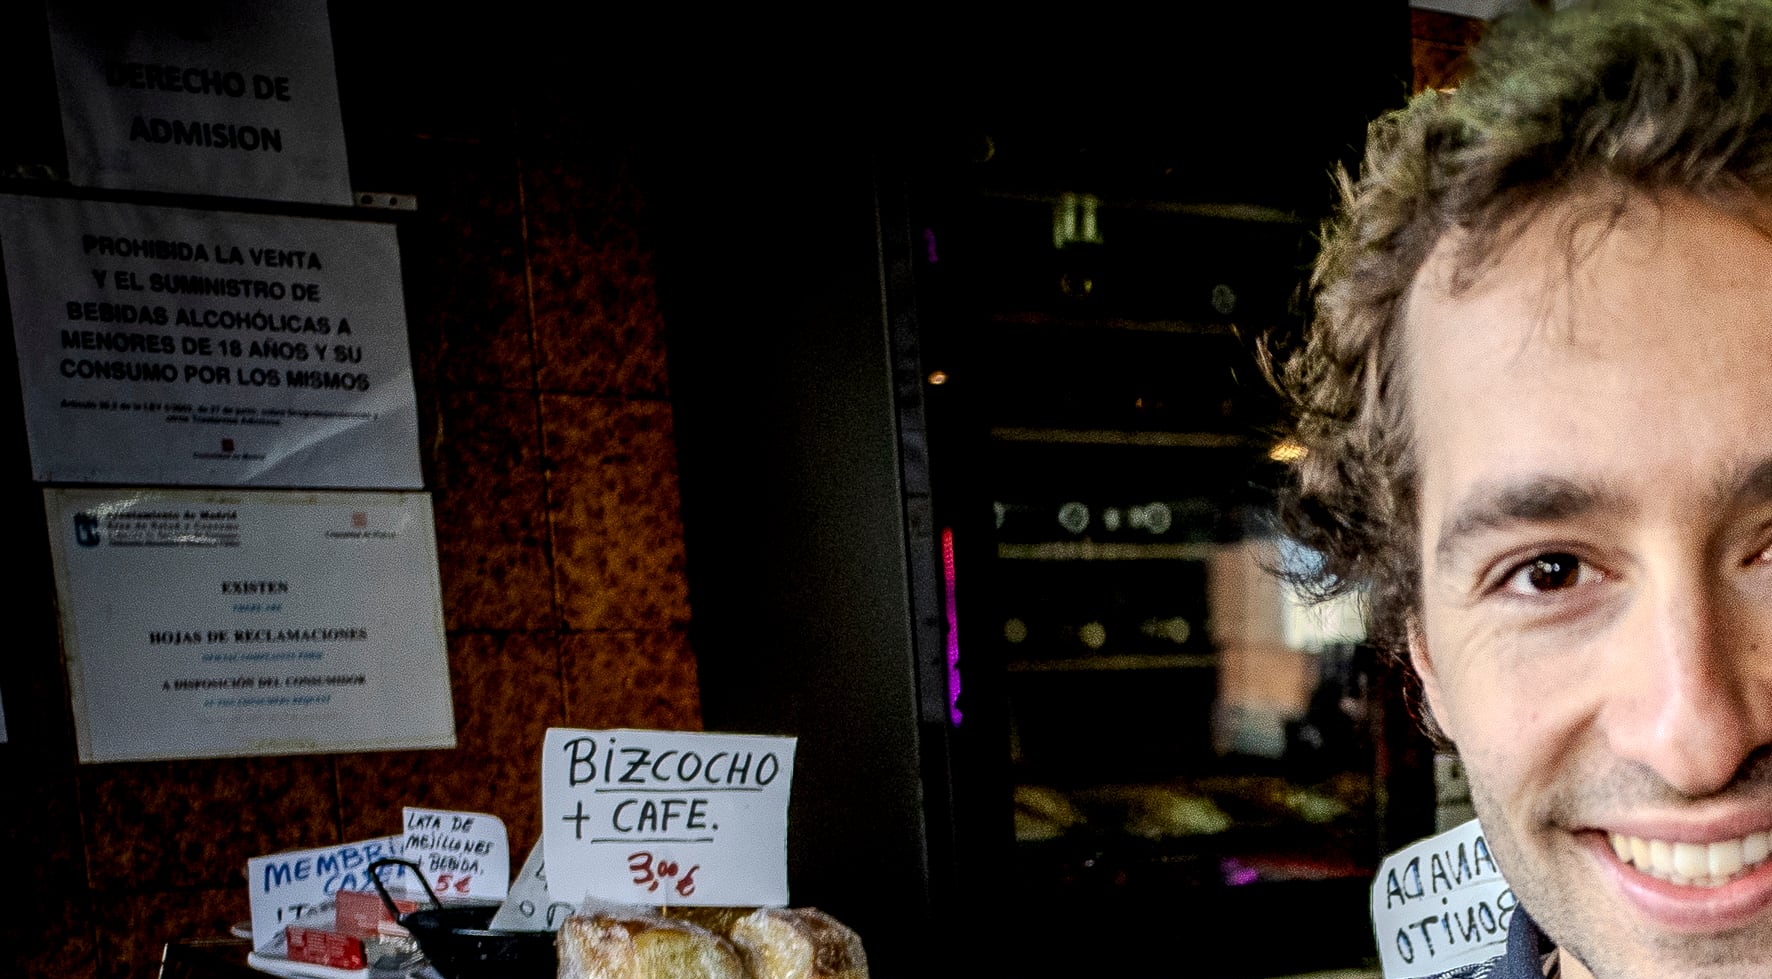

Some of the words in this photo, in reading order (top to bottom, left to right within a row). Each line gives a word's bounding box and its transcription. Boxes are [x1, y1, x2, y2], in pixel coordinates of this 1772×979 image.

[105, 60, 246, 98] DERECHO
[253, 74, 291, 102] DE
[130, 115, 283, 153] ADMISION
[82, 234, 209, 263] PROHIBIDA
[215, 245, 244, 265] LA
[249, 248, 322, 271] VENTA
[92, 269, 107, 289] Y
[114, 271, 144, 291] EL
[150, 273, 286, 300] SUMINISTRO
[291, 283, 321, 303] DE
[66, 301, 169, 327] BEBIDAS
[175, 307, 330, 335] ALCOHÓLICAS
[337, 318, 351, 335] A
[61, 329, 175, 354] MENORES
[182, 336, 212, 356] DE
[220, 339, 242, 358] 18
[250, 337, 308, 361] AÑOS
[315, 344, 328, 361] Y
[334, 345, 362, 364] SU
[59, 358, 178, 383] CONSUMO
[184, 365, 232, 384] POR
[237, 367, 281, 387] LOS
[286, 370, 370, 392] MISMOS
[221, 580, 289, 595] EXISTEN
[150, 628, 201, 646] HOJAS
[207, 630, 228, 643] DE
[234, 627, 368, 644] RECLAMACIONES
[563, 736, 779, 787] BIZCOCHO
[408, 812, 442, 831] LATA
[452, 817, 474, 833] DE
